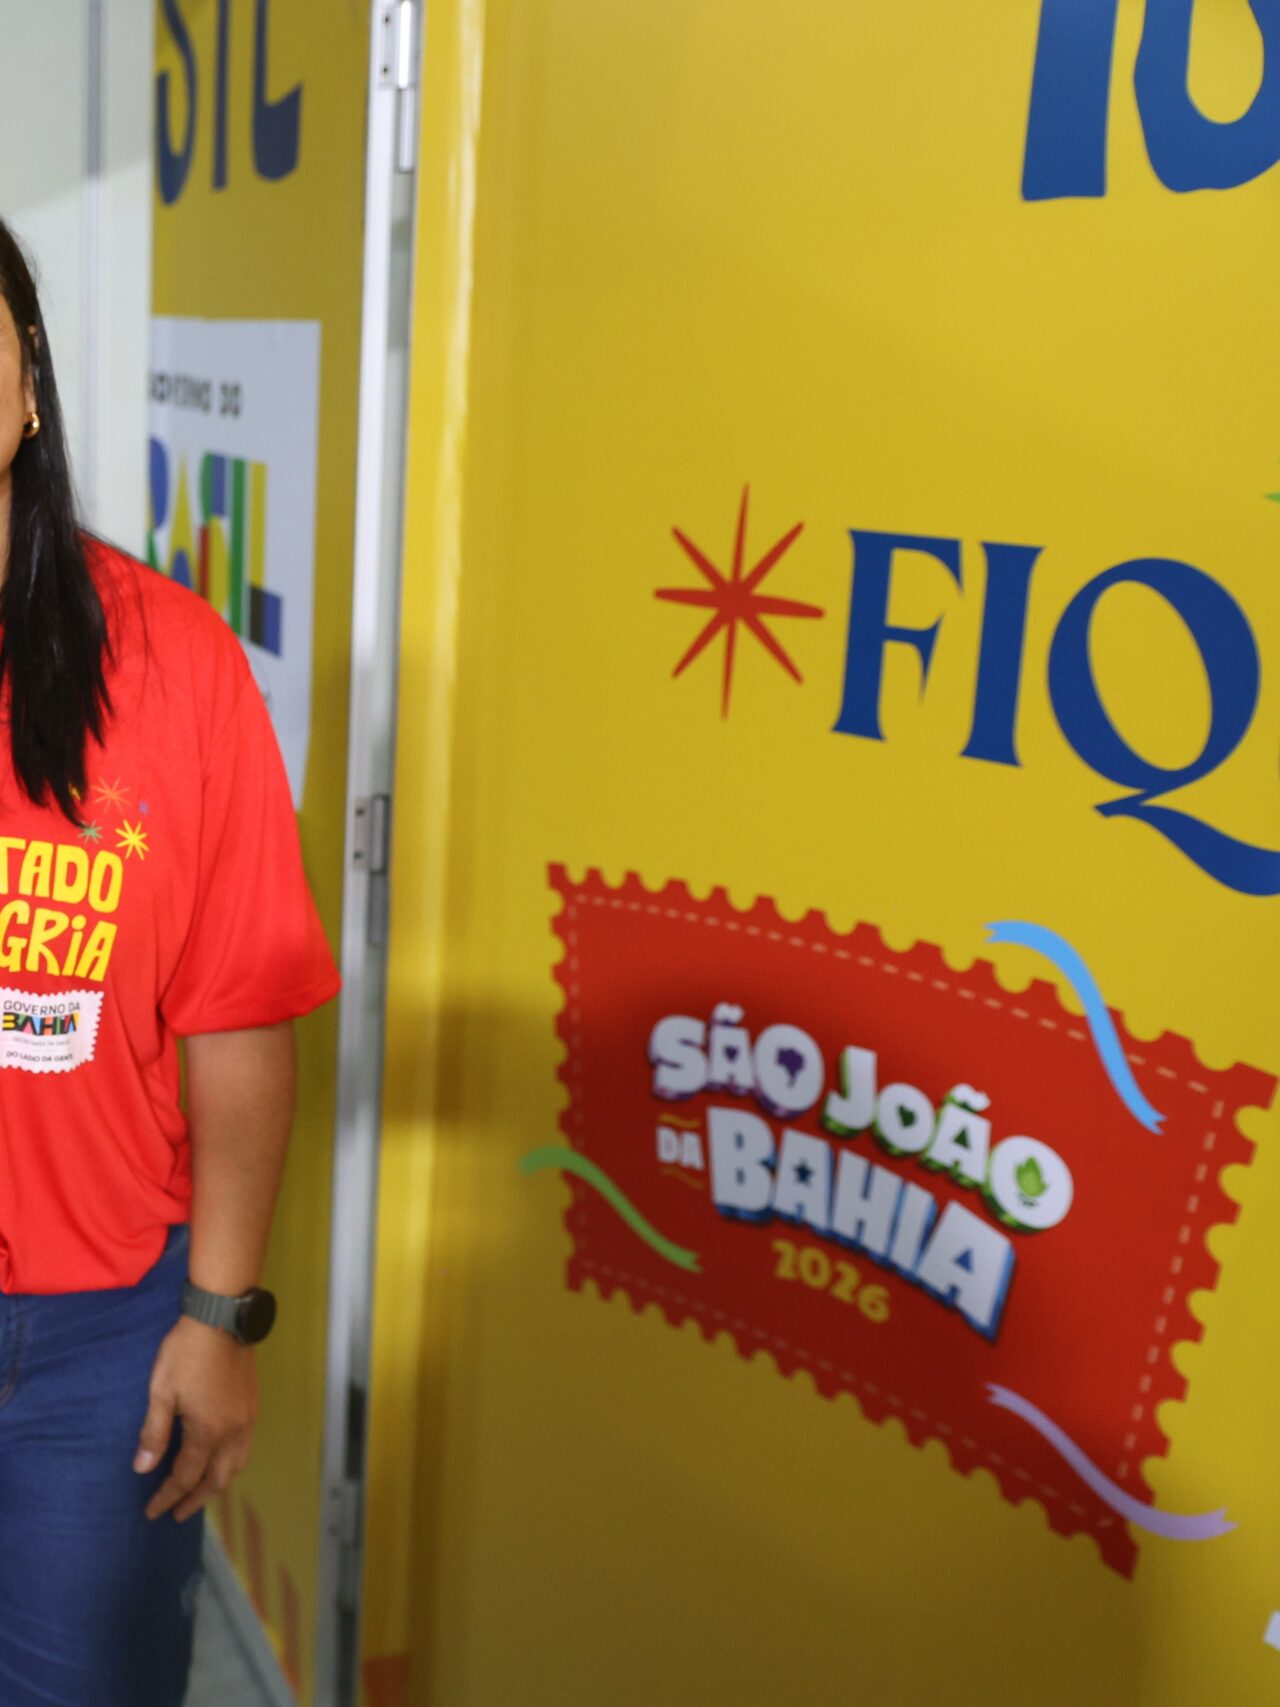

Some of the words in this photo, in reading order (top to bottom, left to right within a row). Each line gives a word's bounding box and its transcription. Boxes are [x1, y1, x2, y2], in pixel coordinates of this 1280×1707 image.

[830, 527, 1280, 897] FIQ
[2, 1011, 80, 1037] BAHIA
[3, 999, 66, 1016] GOVERNO
[68, 1001, 81, 1012] DA
[647, 1002, 826, 1119] SÃO
[822, 1044, 1074, 1234] JOÃO
[655, 1124, 704, 1171] DA
[706, 1104, 1017, 1343] BAHIA
[772, 1238, 891, 1324] 2026
